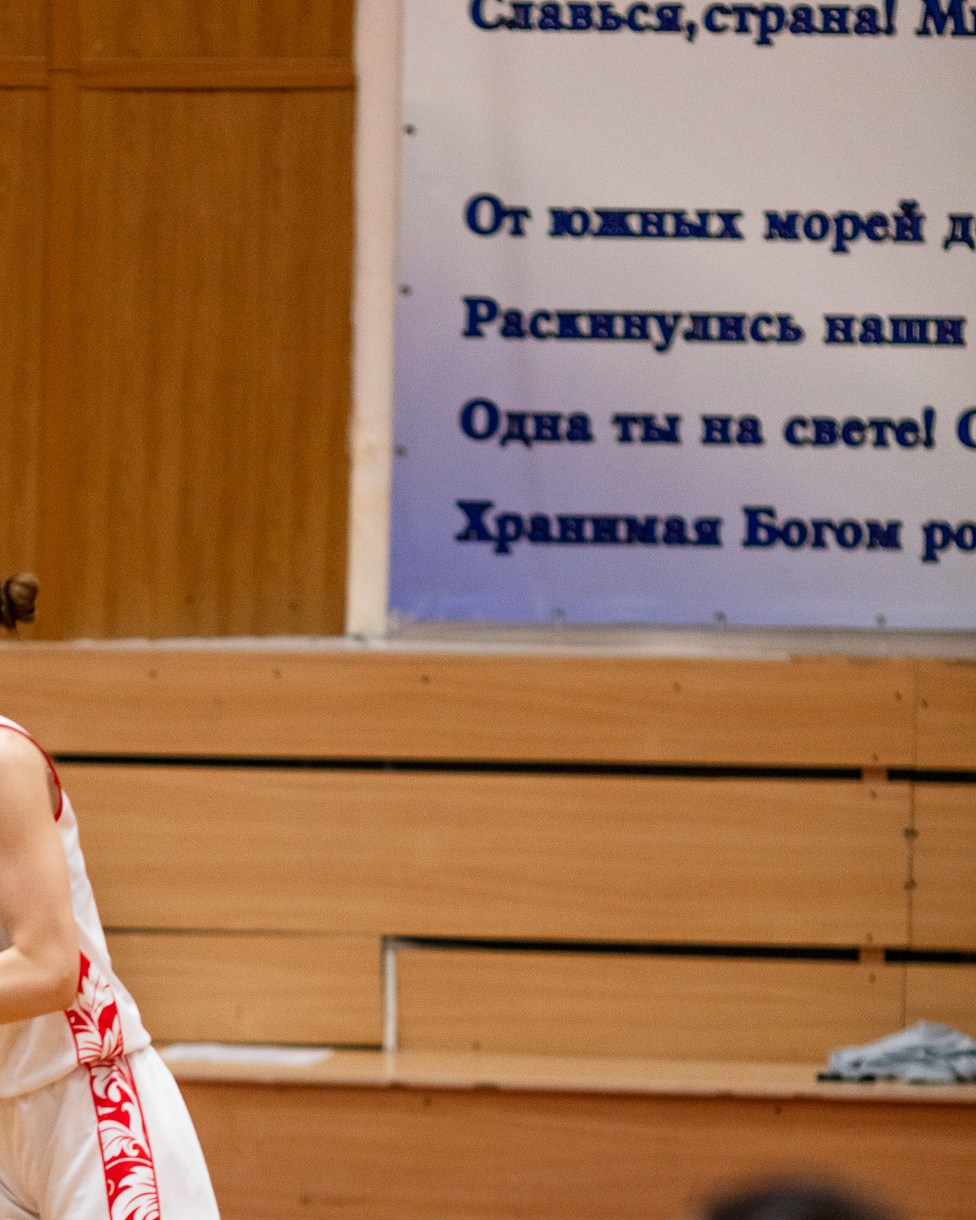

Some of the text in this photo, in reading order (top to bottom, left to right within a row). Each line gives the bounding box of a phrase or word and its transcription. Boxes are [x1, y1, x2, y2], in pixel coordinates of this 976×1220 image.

[465, 194, 531, 238] От
[549, 208, 745, 240] южных
[764, 200, 926, 254] морей
[462, 297, 967, 354] Раскинулись наши
[459, 398, 594, 450] Одна
[612, 414, 682, 445] ты
[702, 415, 765, 446] на
[784, 407, 936, 449] свете!
[454, 500, 724, 556] Хранимая
[742, 507, 902, 551] Богом
